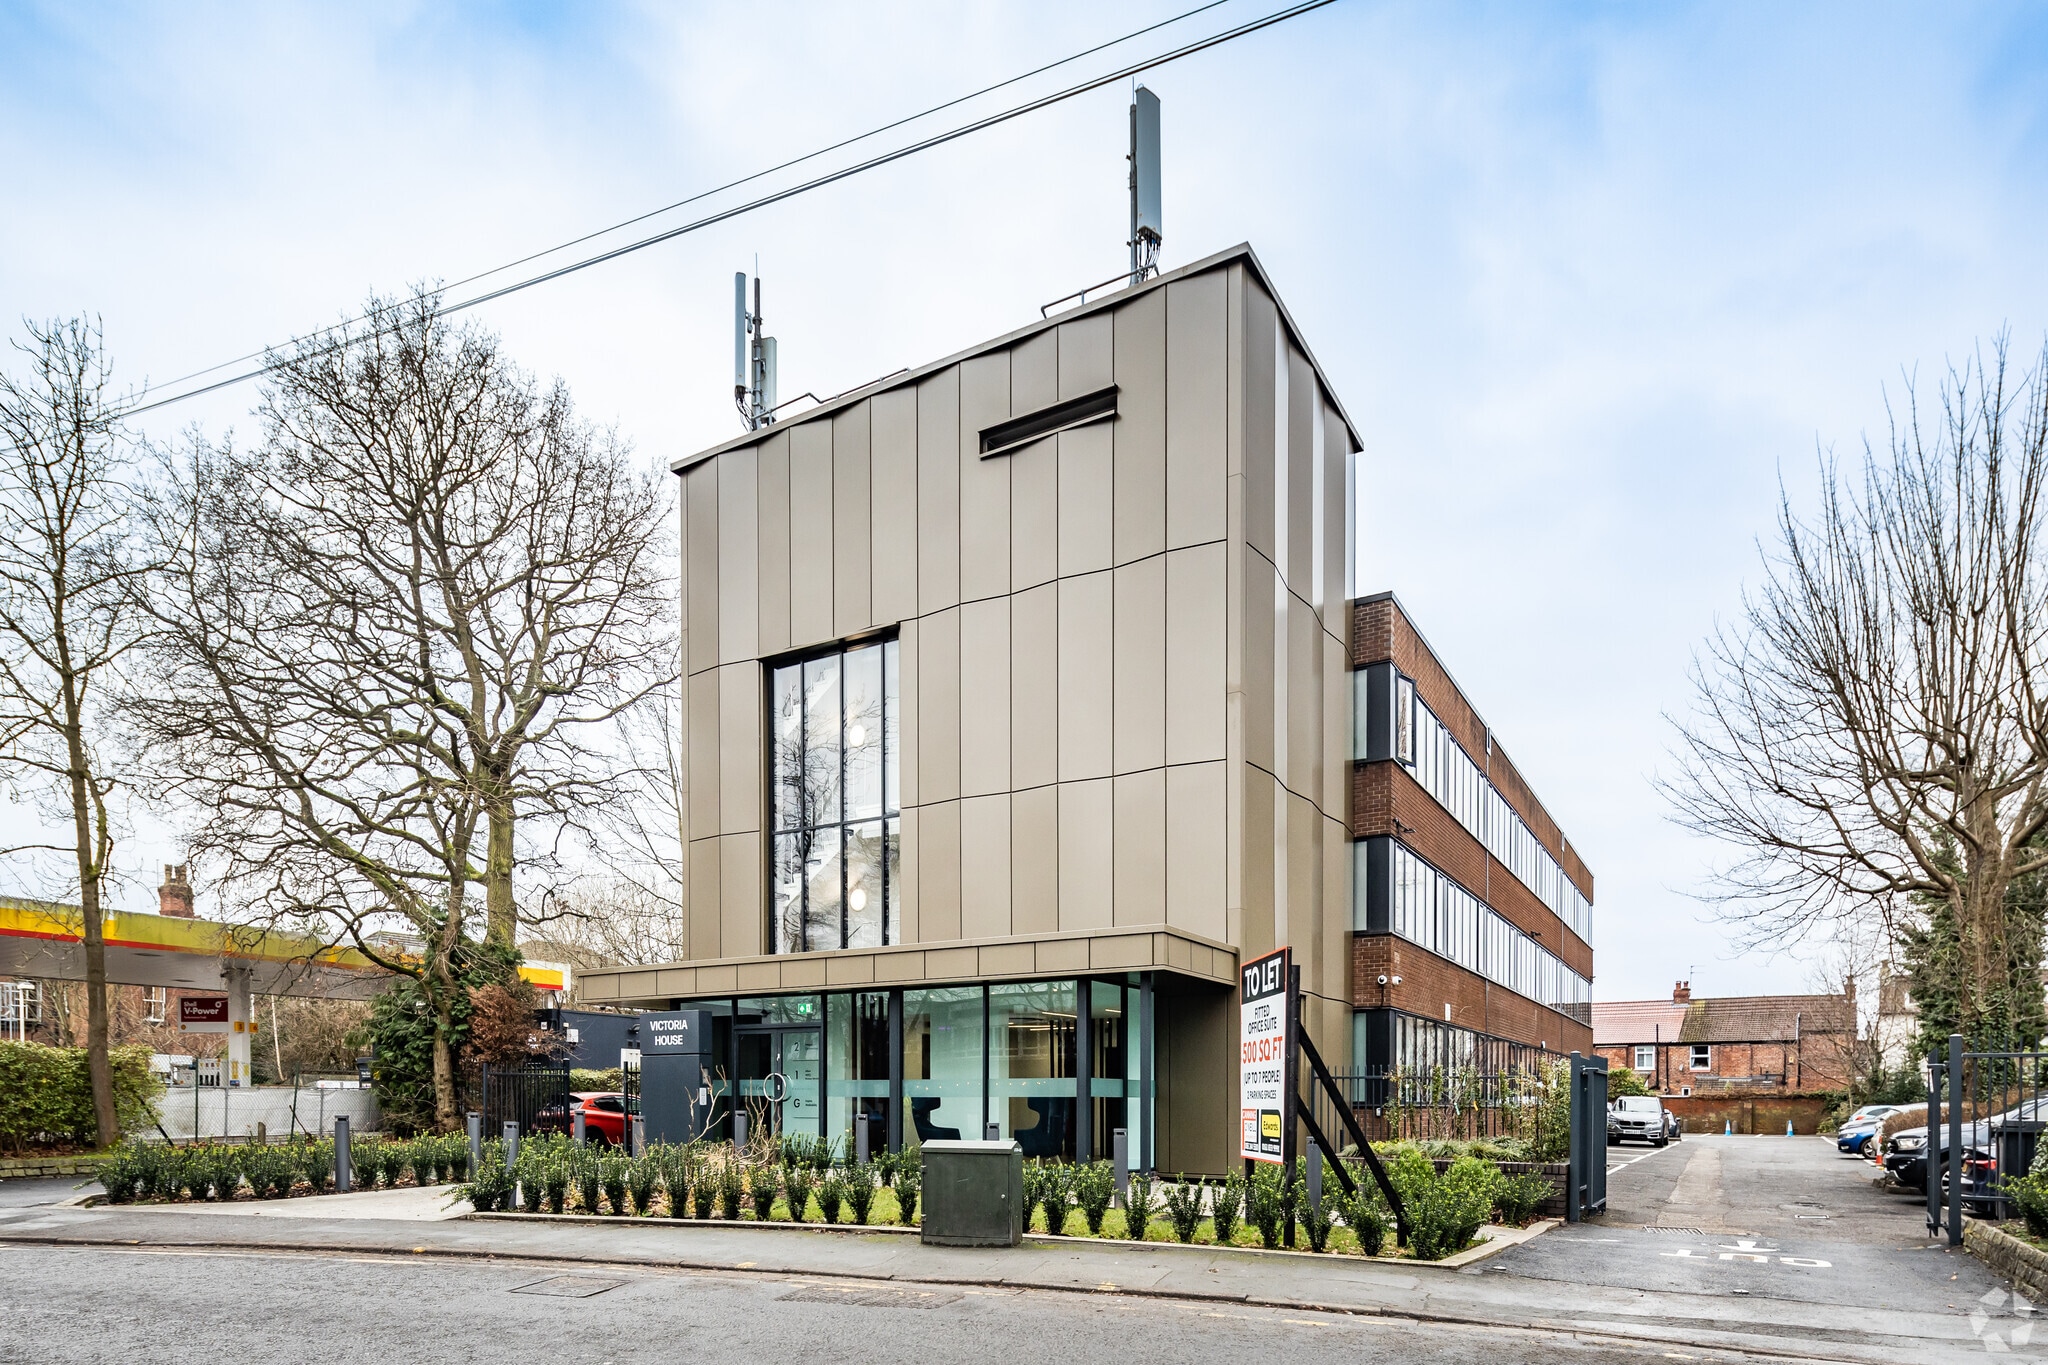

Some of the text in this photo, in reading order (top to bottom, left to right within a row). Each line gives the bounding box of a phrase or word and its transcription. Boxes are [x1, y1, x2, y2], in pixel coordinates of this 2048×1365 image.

[1245, 957, 1281, 997] TO LET
[1255, 1005, 1270, 1019] FITTED
[650, 1020, 688, 1031] VICTORIA
[1248, 1017, 1277, 1034] OFFICE SUITE
[655, 1035, 683, 1046] HOUSE
[794, 1042, 799, 1051] 2
[1243, 1036, 1282, 1064] 500 SQ FT
[795, 1070, 798, 1079] 1
[1252, 1071, 1257, 1084] TO
[1262, 1070, 1281, 1084] PEOPLE)
[793, 1098, 800, 1108] G
[1263, 1120, 1279, 1131] Edwards
[1659, 1249, 1833, 1267] OUT
